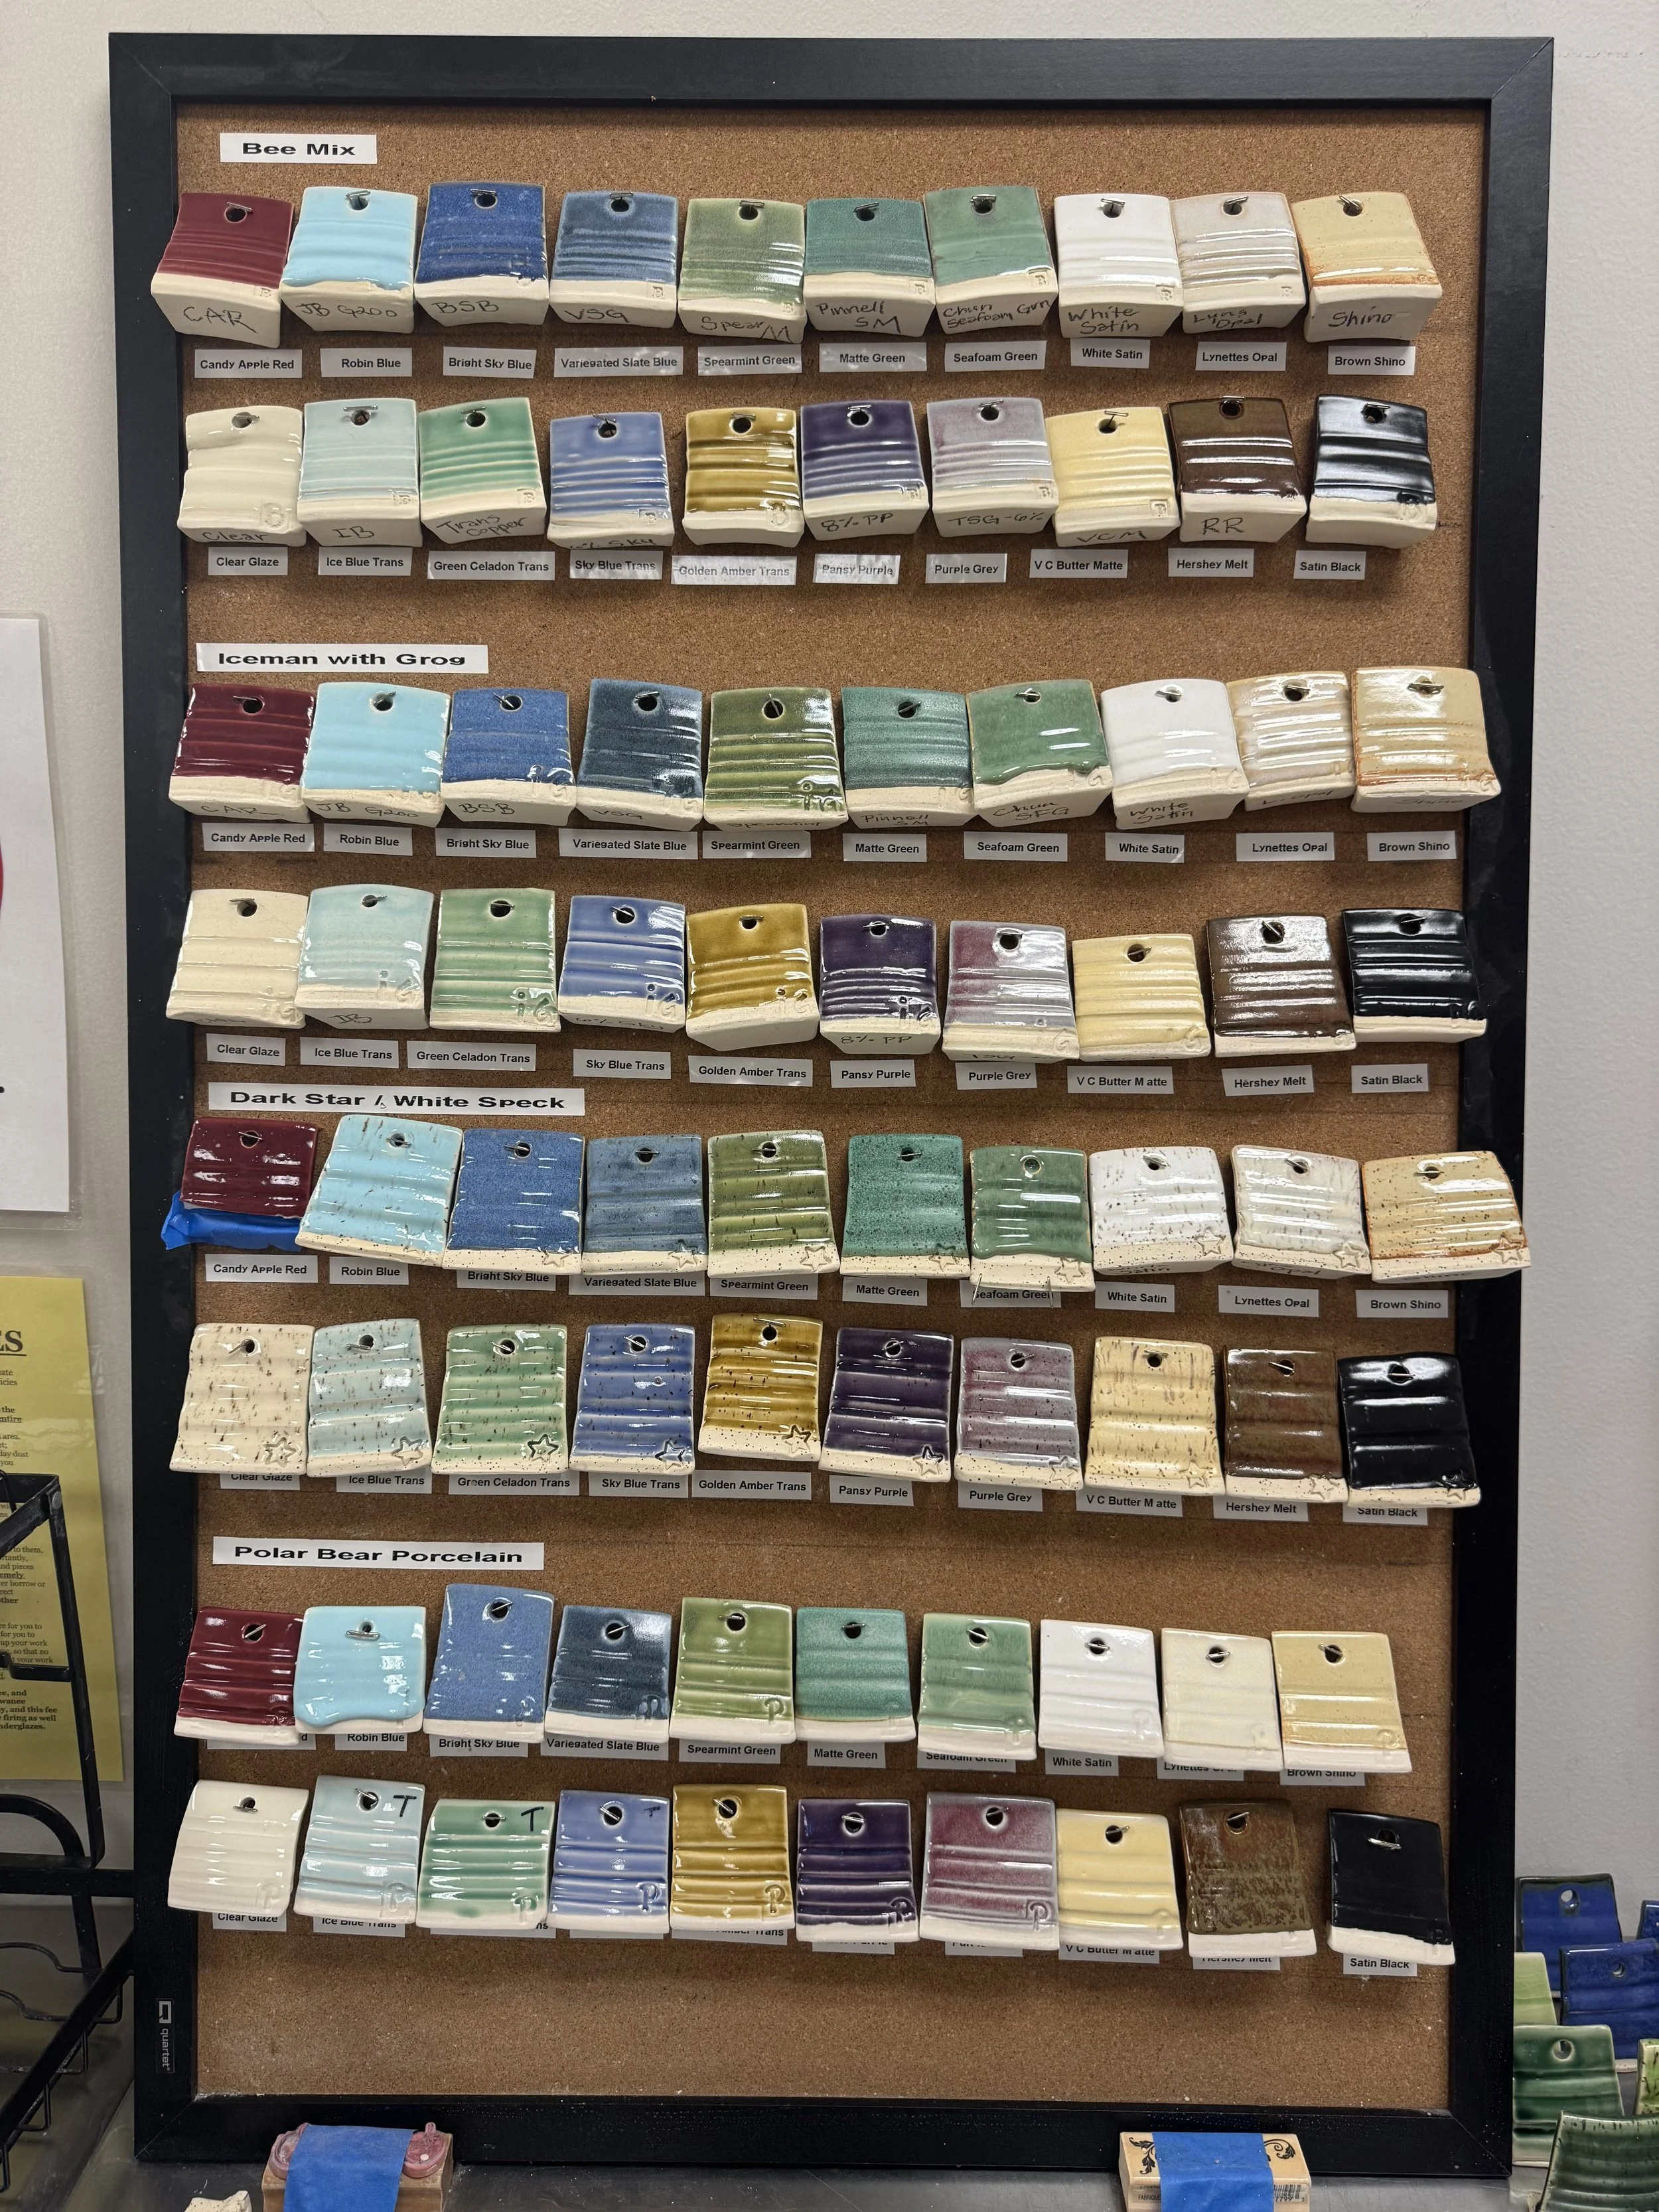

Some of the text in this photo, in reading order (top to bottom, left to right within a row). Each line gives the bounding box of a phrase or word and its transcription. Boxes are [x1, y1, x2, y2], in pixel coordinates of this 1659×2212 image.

[243, 143, 356, 156] Bee Mix
[431, 300, 499, 314] BSB
[183, 306, 257, 334] CAR
[1068, 307, 1139, 322] White
[1328, 305, 1394, 328] Shino
[1079, 319, 1140, 334] Satin
[839, 353, 906, 363] Matte Green
[954, 352, 1038, 362] Seafoam Green
[1082, 348, 1143, 359] White Satin
[1202, 352, 1277, 362] Lynettes Opal
[200, 360, 294, 370] Candy Apple Red
[341, 358, 401, 368] Robin Blue
[449, 357, 532, 370] Bright Sky Blue
[560, 357, 678, 368] Variegated Slate Blue
[704, 355, 795, 366] Spearmint Green
[1334, 356, 1406, 366] Brown Shino
[1201, 517, 1246, 535] RR
[216, 557, 279, 567] Clear Glaze
[326, 557, 404, 567] Ice Blue Trans
[433, 561, 549, 571] Green Celadon Trans
[575, 560, 656, 571] Sky Blue Trans
[1034, 560, 1123, 570] V C Butter Matte
[1177, 559, 1248, 569] Hershey Melt
[1299, 561, 1361, 572] Satin Black
[822, 564, 894, 576] Pansy Purple
[934, 564, 999, 574] Purple Grey
[218, 653, 465, 666] Iceman with Grog
[211, 833, 305, 843] Candy Apple Red
[340, 834, 399, 846] Robin Blue
[447, 838, 530, 849] Bright Sky Blue
[572, 839, 687, 851] Variegated Slate Blue
[711, 840, 800, 849] Spearmint Green
[855, 843, 919, 853] Matte Green
[977, 842, 1060, 853] Seafoam Green
[1119, 843, 1179, 854] White Satin
[1252, 842, 1328, 853] Lynettes Opal
[1379, 842, 1450, 852] Brown Shino
[217, 1044, 280, 1057] Clear Glaze
[315, 1047, 392, 1059] Ice Blue Trans
[416, 1051, 530, 1063] Green Celadon Trans
[586, 1059, 665, 1070] Sky Blue Trans
[699, 1065, 806, 1078] Golden Amber Trans
[841, 1069, 911, 1079] Pansy Purple
[969, 1070, 1031, 1081] Purple Grey
[1234, 1076, 1306, 1088] Hershey Melt
[1360, 1074, 1423, 1085] Satin Black
[230, 1092, 565, 1108] Dark Star / White Speck
[213, 1264, 307, 1274] Candy Apple Red
[341, 1266, 400, 1276] Robin Blue
[856, 1284, 920, 1297] Matte Green
[1107, 1291, 1167, 1303] White Satin
[699, 1479, 806, 1491] Golden Amber Trans
[839, 1485, 908, 1497] Pansy Purple
[235, 1546, 522, 1562] Polar Bear Porcelain
[687, 1744, 776, 1755] Spearmint Green
[814, 1748, 878, 1759] Matte Green
[1052, 1757, 1112, 1767] White Satin
[393, 1794, 417, 1818] T
[520, 1806, 544, 1832] T
[1350, 1958, 1409, 1968] Satin Black
[160, 2028, 170, 2068] quartet
